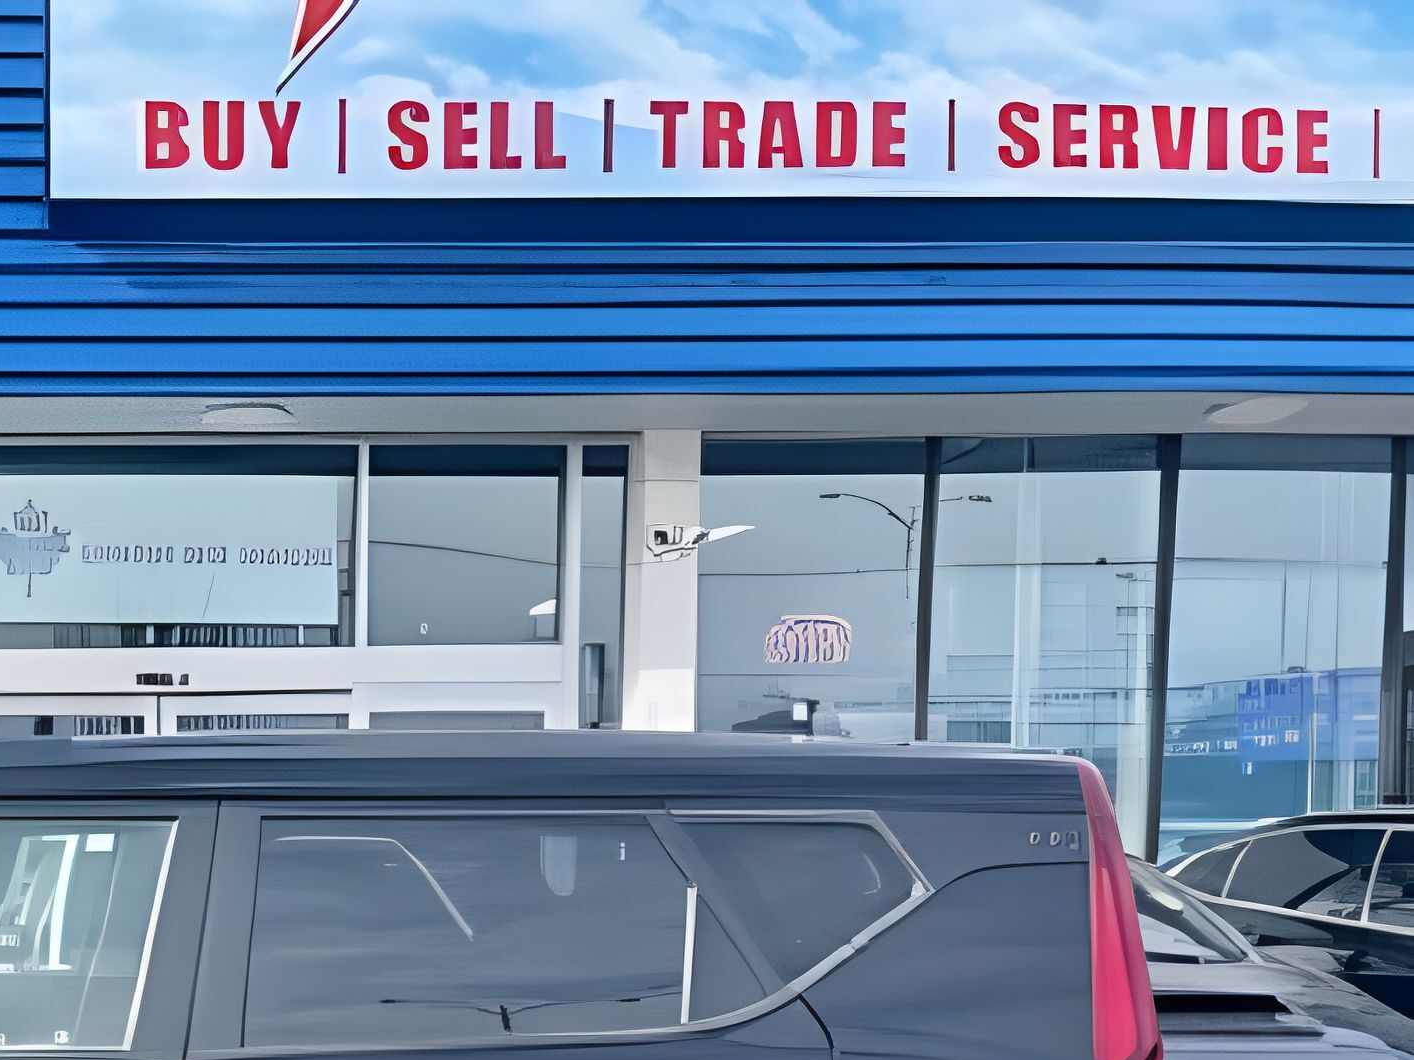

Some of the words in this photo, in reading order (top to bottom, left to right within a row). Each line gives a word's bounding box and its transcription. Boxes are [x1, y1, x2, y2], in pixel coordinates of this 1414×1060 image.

[143, 100, 302, 171] BUY
[386, 99, 567, 171] SELL
[649, 100, 907, 169] TRADE
[996, 101, 1330, 175] SERVICE
